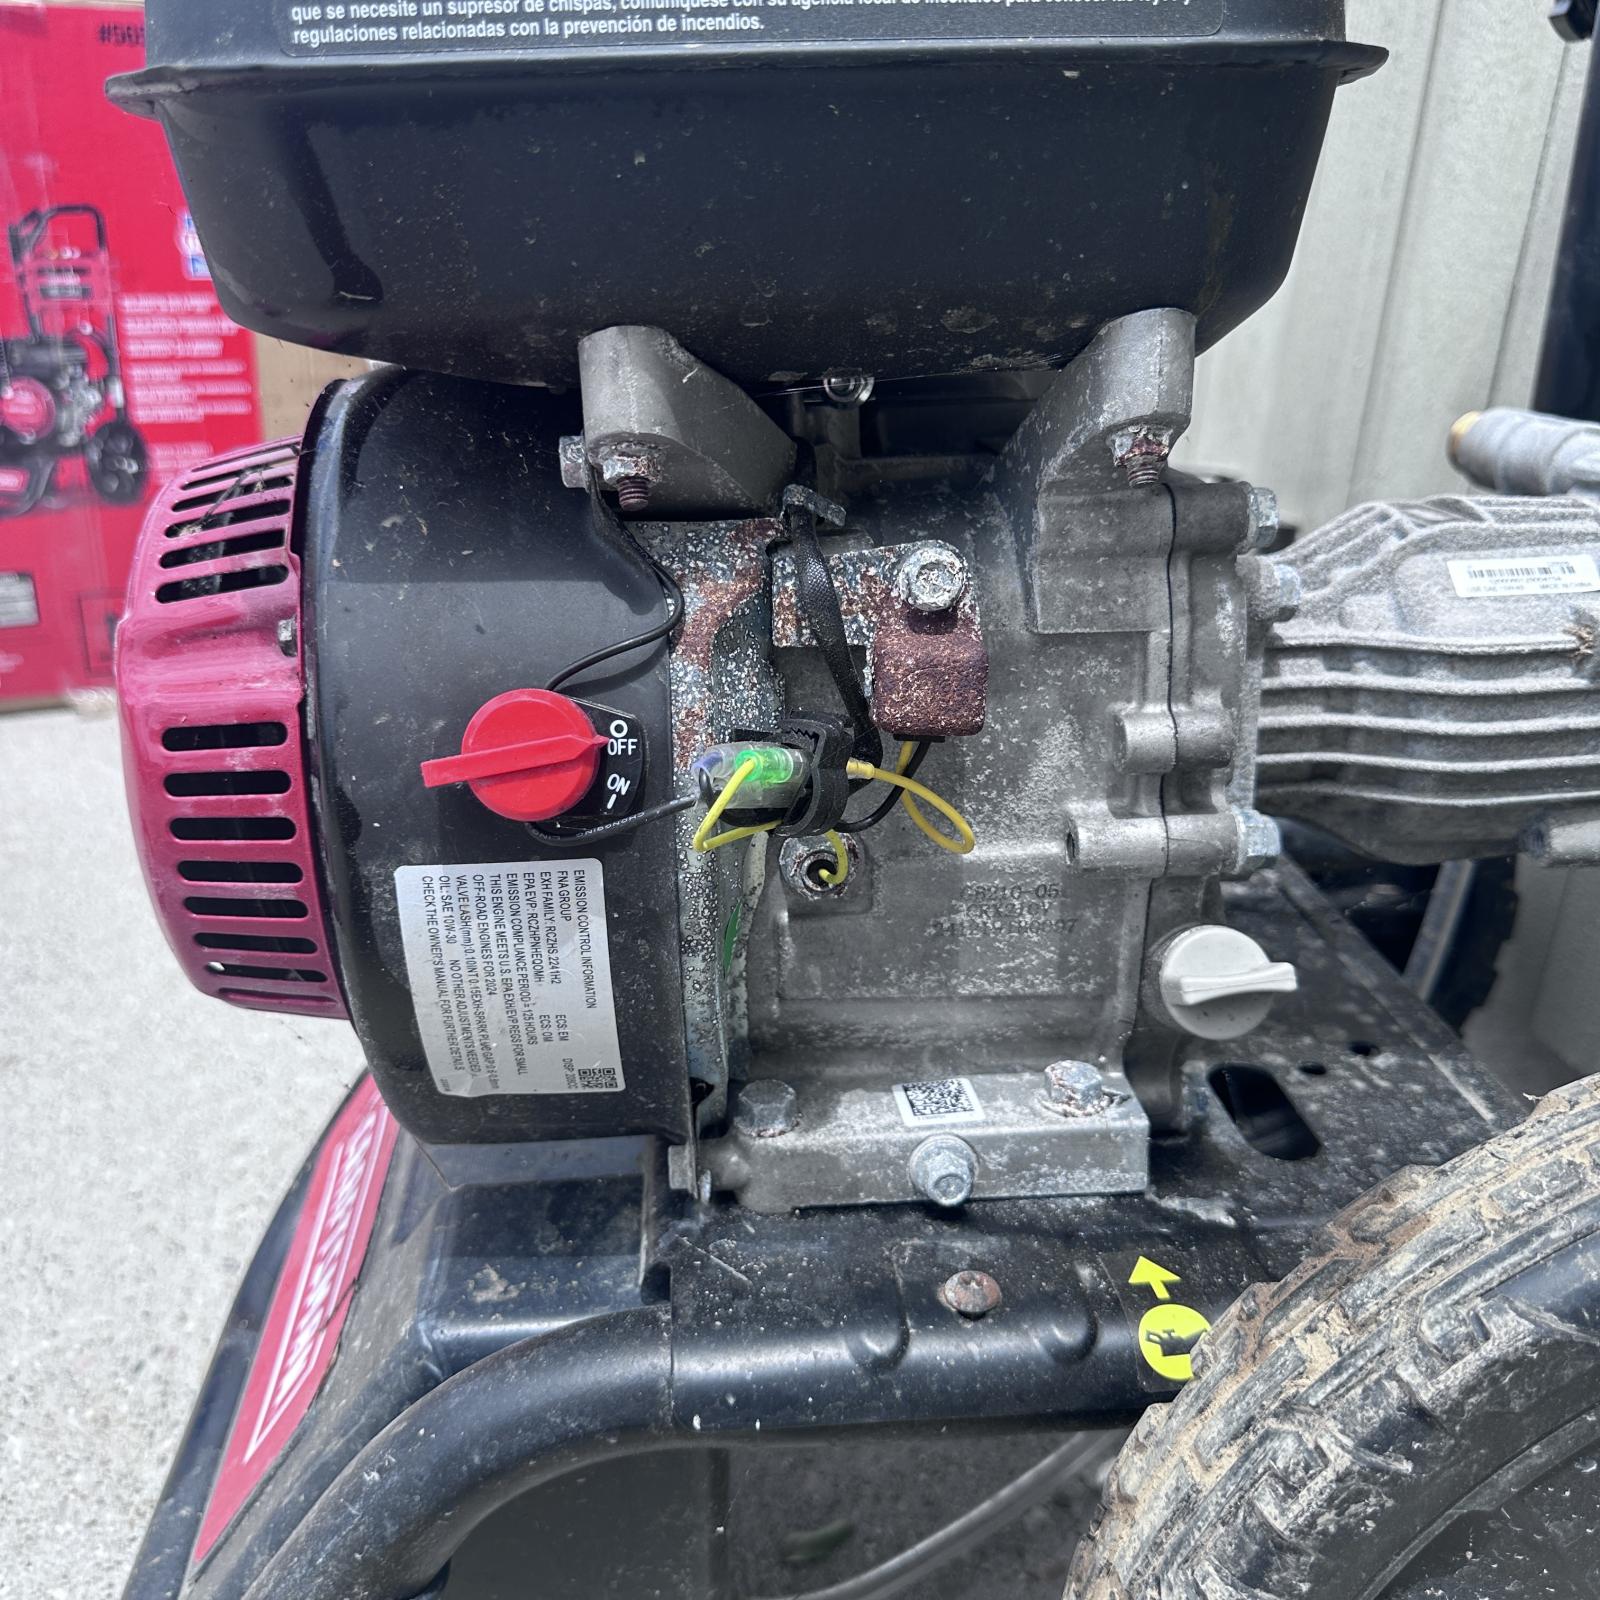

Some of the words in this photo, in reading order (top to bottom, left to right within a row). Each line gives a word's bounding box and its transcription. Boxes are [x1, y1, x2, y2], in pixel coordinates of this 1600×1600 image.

[291, 6, 321, 24] que
[326, 5, 345, 19] se
[350, 0, 417, 18] necesite
[422, 2, 442, 16] un
[448, 0, 520, 18] supresor
[524, 0, 544, 12] de
[549, 0, 617, 15] chispas,
[293, 25, 397, 48] regulaciones
[402, 21, 505, 40] relacionadas
[510, 21, 539, 36] con
[545, 18, 558, 35] la
[564, 15, 652, 38] prevención
[656, 14, 677, 32] de
[681, 13, 765, 31] incendios.
[607, 739, 638, 755] OFF
[607, 774, 630, 795] ON
[422, 876, 436, 907] CHECK
[439, 876, 451, 893] OIL:
[456, 875, 469, 902] VALVE
[490, 874, 502, 894] THIS
[524, 873, 535, 890] EPA
[541, 872, 552, 890] EXH
[557, 871, 569, 888] FNA
[574, 870, 588, 912] EMISSION
[442, 895, 453, 912] SAE
[473, 875, 487, 920] OFF-ROAD
[507, 874, 521, 916] EMISSION
[525, 891, 537, 911] EVP:
[559, 890, 571, 921] GROUP
[426, 909, 438, 926] THE
[492, 897, 505, 929] ENGINE
[542, 892, 555, 924] FAMILY:
[443, 916, 457, 944] 10W-30
[478, 923, 492, 959] ENGINES
[578, 915, 591, 955] CONTROL
[429, 928, 444, 965] OWNER'S
[496, 932, 509, 959] MEETS
[511, 918, 527, 972] COMPLIANCE
[545, 926, 561, 984] RCZHS.2241H2
[450, 960, 461, 971] NO
[483, 961, 495, 977] FOR
[499, 961, 511, 976] U.S.
[434, 968, 448, 998] MANUAL
[452, 973, 465, 998] OTHER
[485, 979, 497, 995] 2024
[502, 978, 513, 992] EPA
[518, 974, 531, 1001] PERIOD
[582, 957, 597, 1008] INFORMATION
[440, 1000, 452, 1014] FOR
[504, 994, 518, 1023] EXH/EVP
[522, 1010, 534, 1021] 125
[443, 1016, 458, 1046] FURTHER
[457, 1000, 475, 1048] ADJUSTMENTS
[509, 1025, 522, 1043] REGS
[525, 1022, 538, 1044] HOURS
[539, 1015, 552, 1030] ECS:
[556, 1015, 567, 1030] ECS:
[558, 1032, 569, 1041] EM
[513, 1044, 524, 1056] FOR
